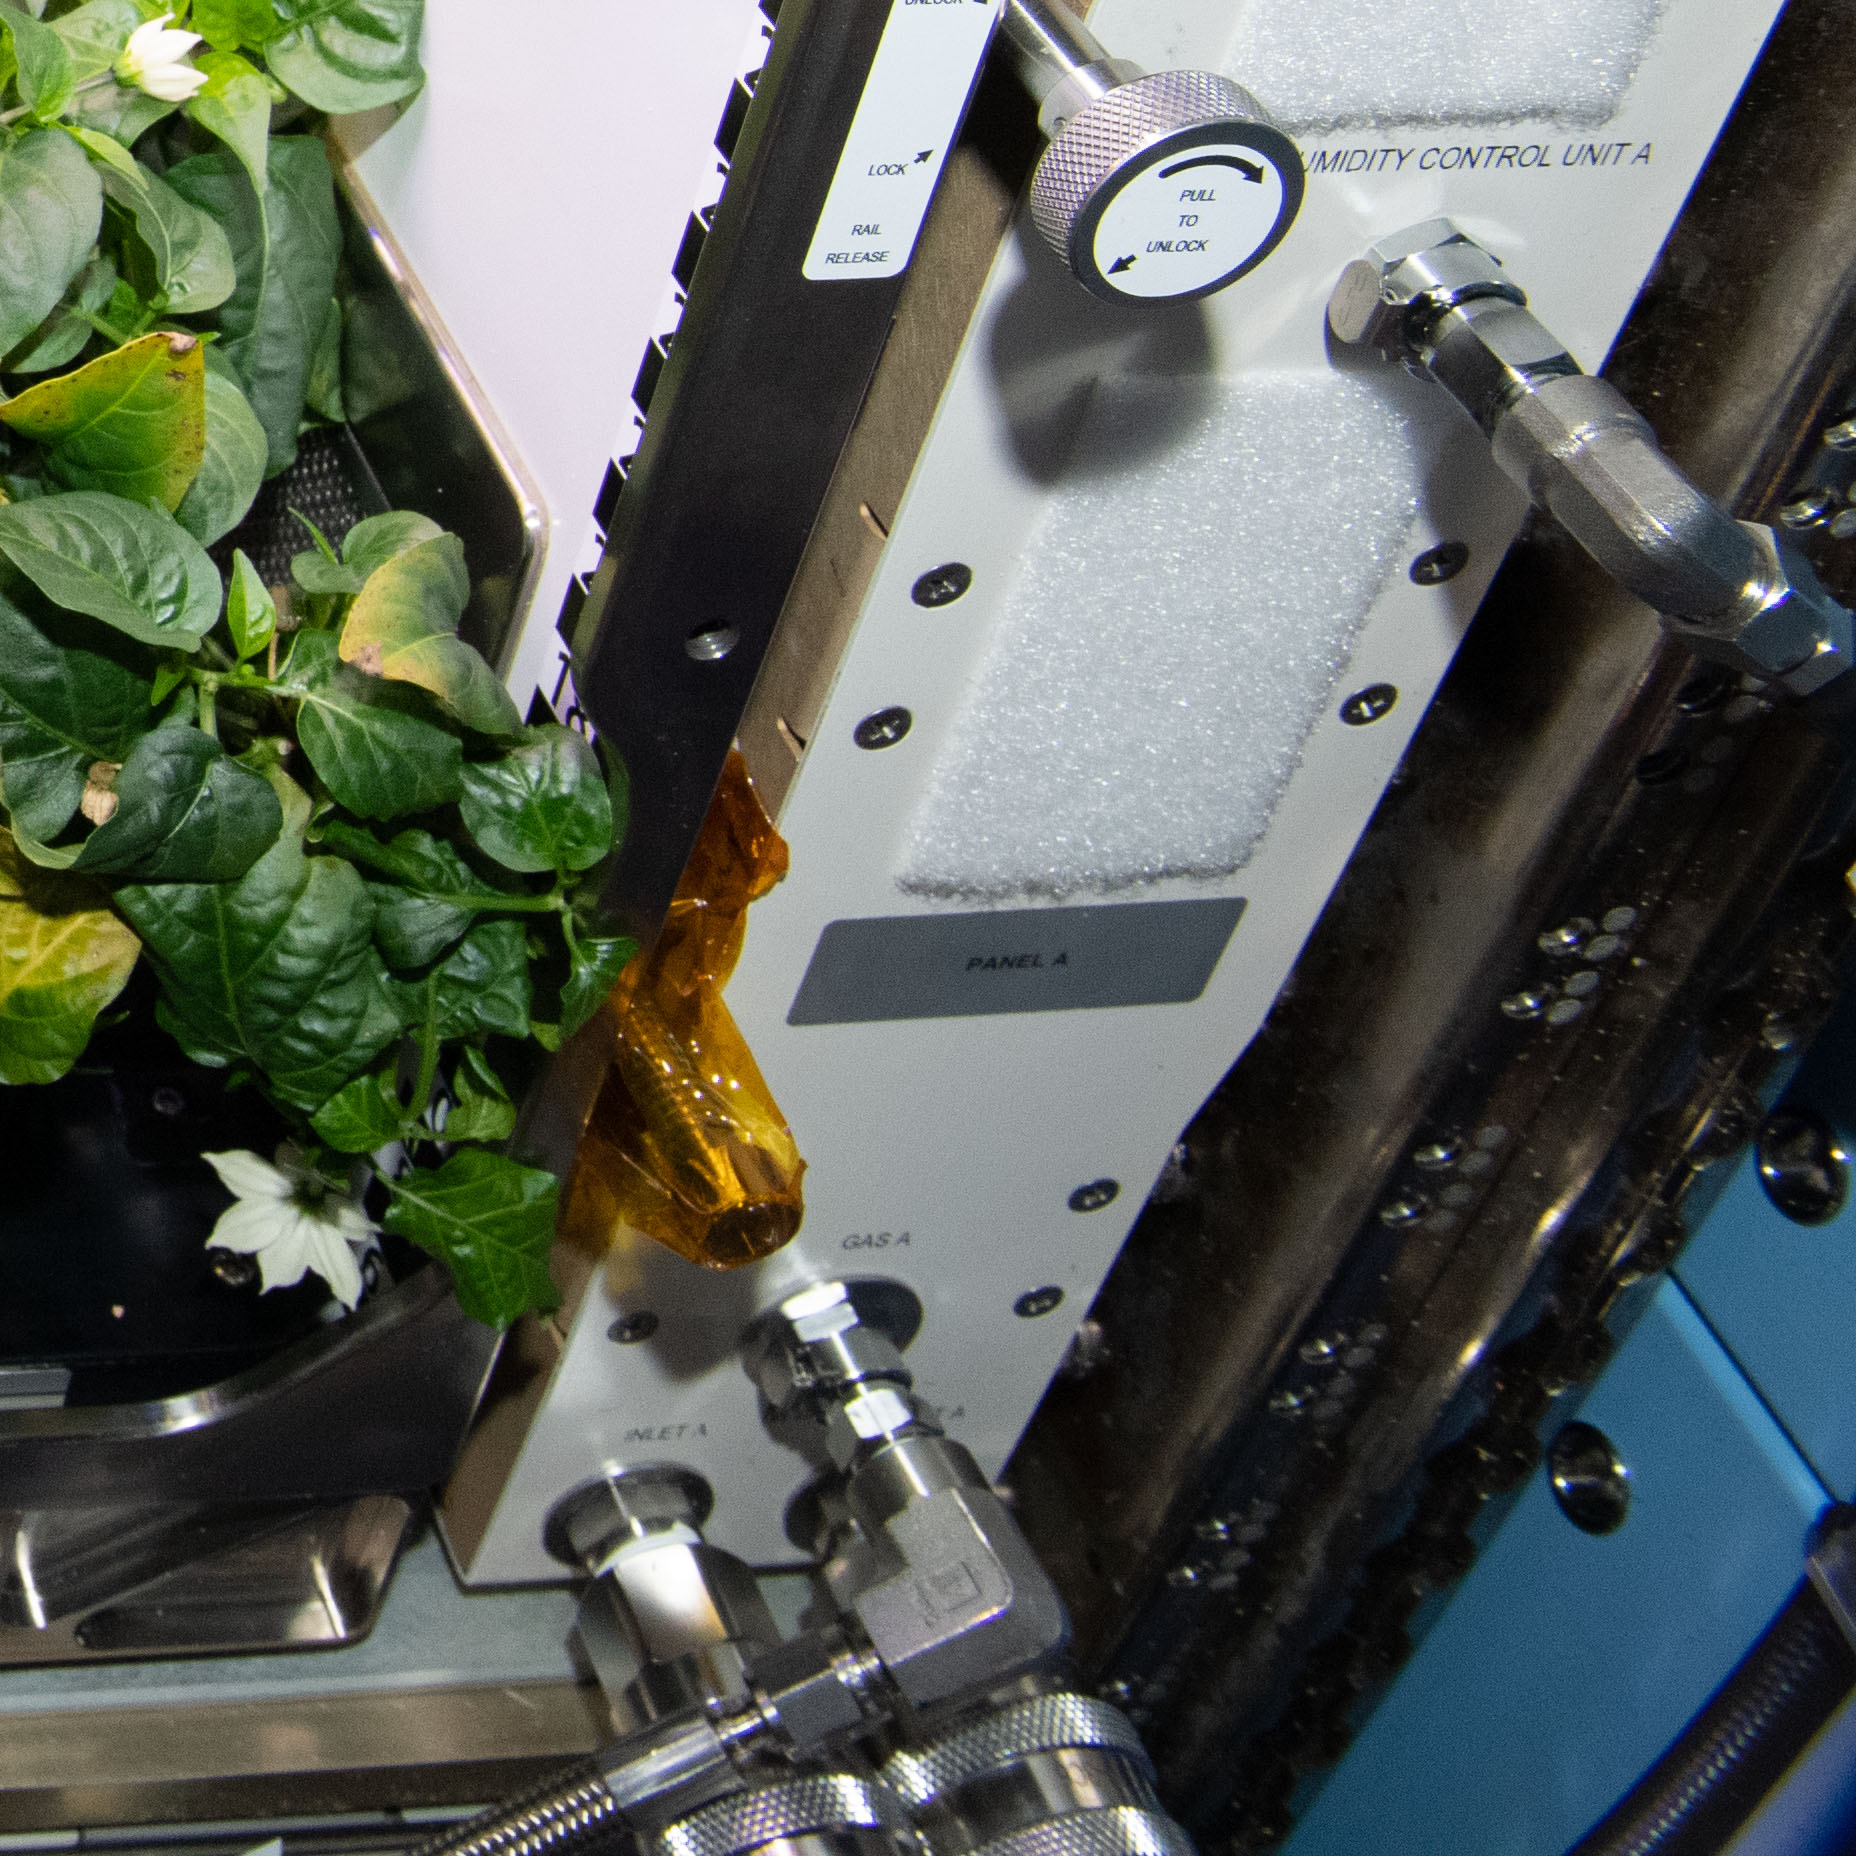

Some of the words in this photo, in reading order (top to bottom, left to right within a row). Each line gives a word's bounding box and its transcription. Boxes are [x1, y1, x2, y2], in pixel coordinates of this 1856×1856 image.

[1302, 147, 1414, 174] UMIDITY
[1418, 145, 1554, 170] CONTROL
[1562, 143, 1633, 168] UNIT
[1630, 142, 1654, 166] A
[867, 163, 909, 176] LOCK
[1178, 189, 1216, 202] PULL
[1178, 214, 1199, 227] TO
[850, 223, 882, 236] RAIL
[1145, 239, 1210, 253] UNLOCK
[824, 251, 890, 264] RELEASE
